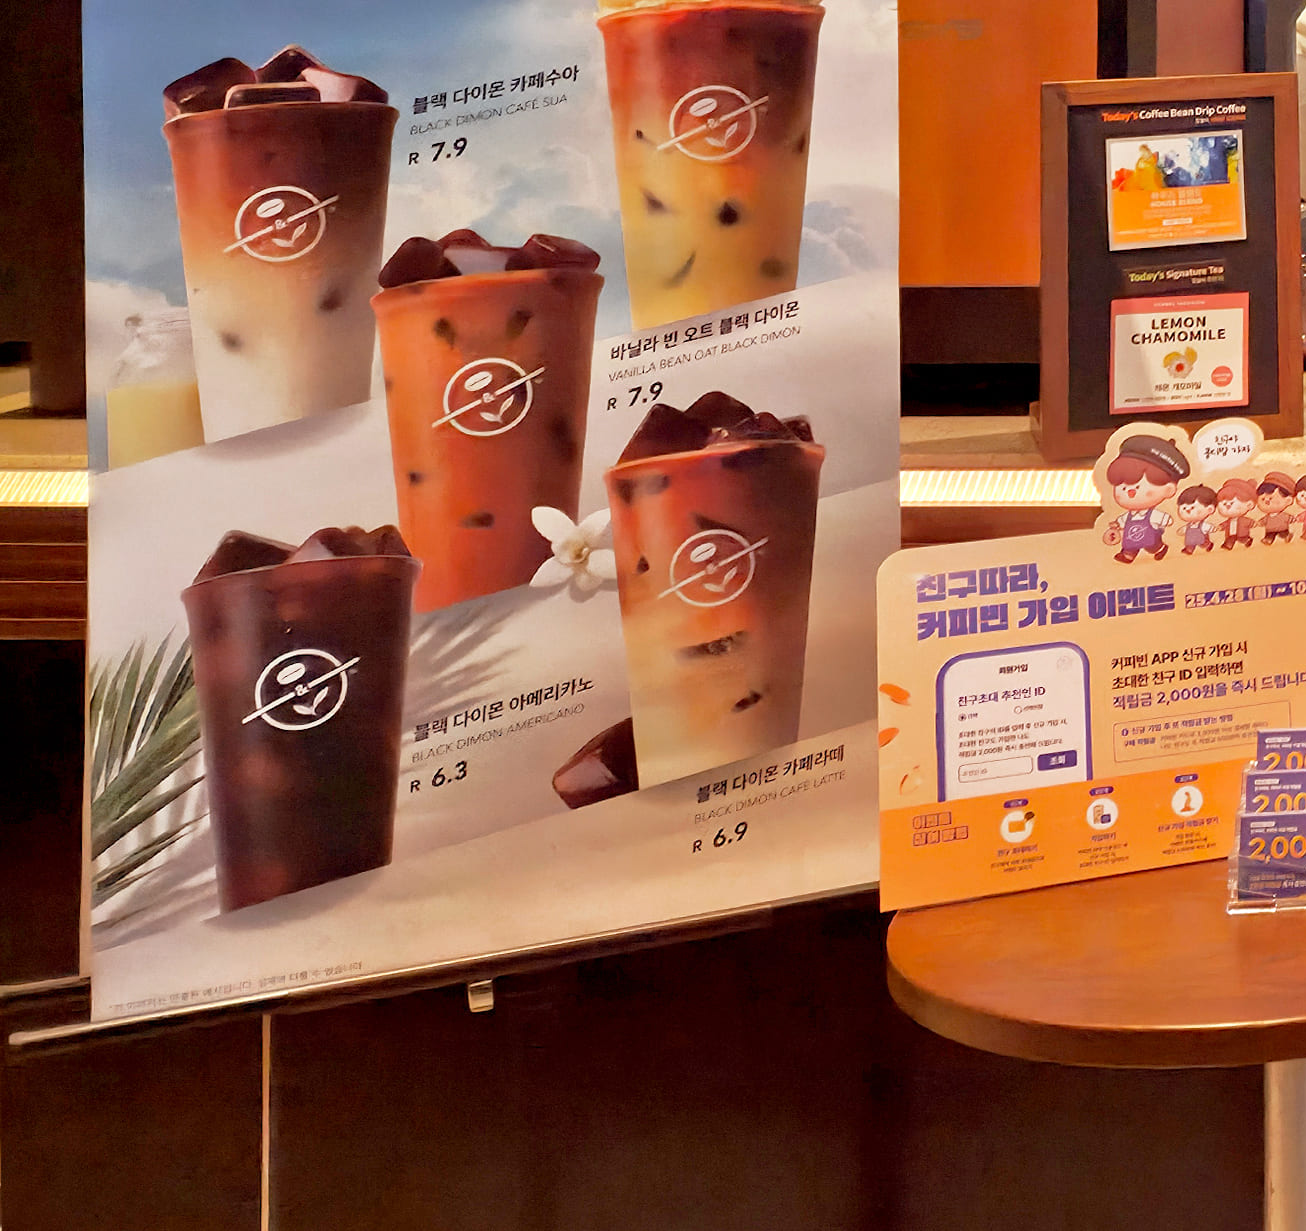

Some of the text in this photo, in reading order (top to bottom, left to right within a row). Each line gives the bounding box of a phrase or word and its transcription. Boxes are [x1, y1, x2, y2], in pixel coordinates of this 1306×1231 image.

[413, 65, 579, 114] 블랙 다이몬 카페수아
[1139, 109, 1168, 119] Coffee
[1171, 107, 1193, 117] Bean
[1196, 106, 1215, 117] Drip
[1217, 104, 1246, 114] Coffee
[409, 138, 467, 165] R 7.9
[611, 301, 799, 360] 바닐라 빈 오트 블랙 다이몬
[1131, 329, 1226, 344] CHAMOMILE
[1152, 317, 1206, 330] LEMON
[609, 326, 800, 382] VANILLA BEAN OAT BLACK DIMON
[607, 381, 663, 411] R 7.9
[916, 563, 1048, 602] 친구따라,
[917, 583, 1175, 641] 커피빈 가입 이벤트
[1111, 642, 1248, 670] 커피빈 APP 신규 가입 시
[415, 678, 594, 742] 블랙 다이몬 아메리카노
[410, 760, 467, 793] R 6.3
[693, 822, 748, 853] R 6.9
